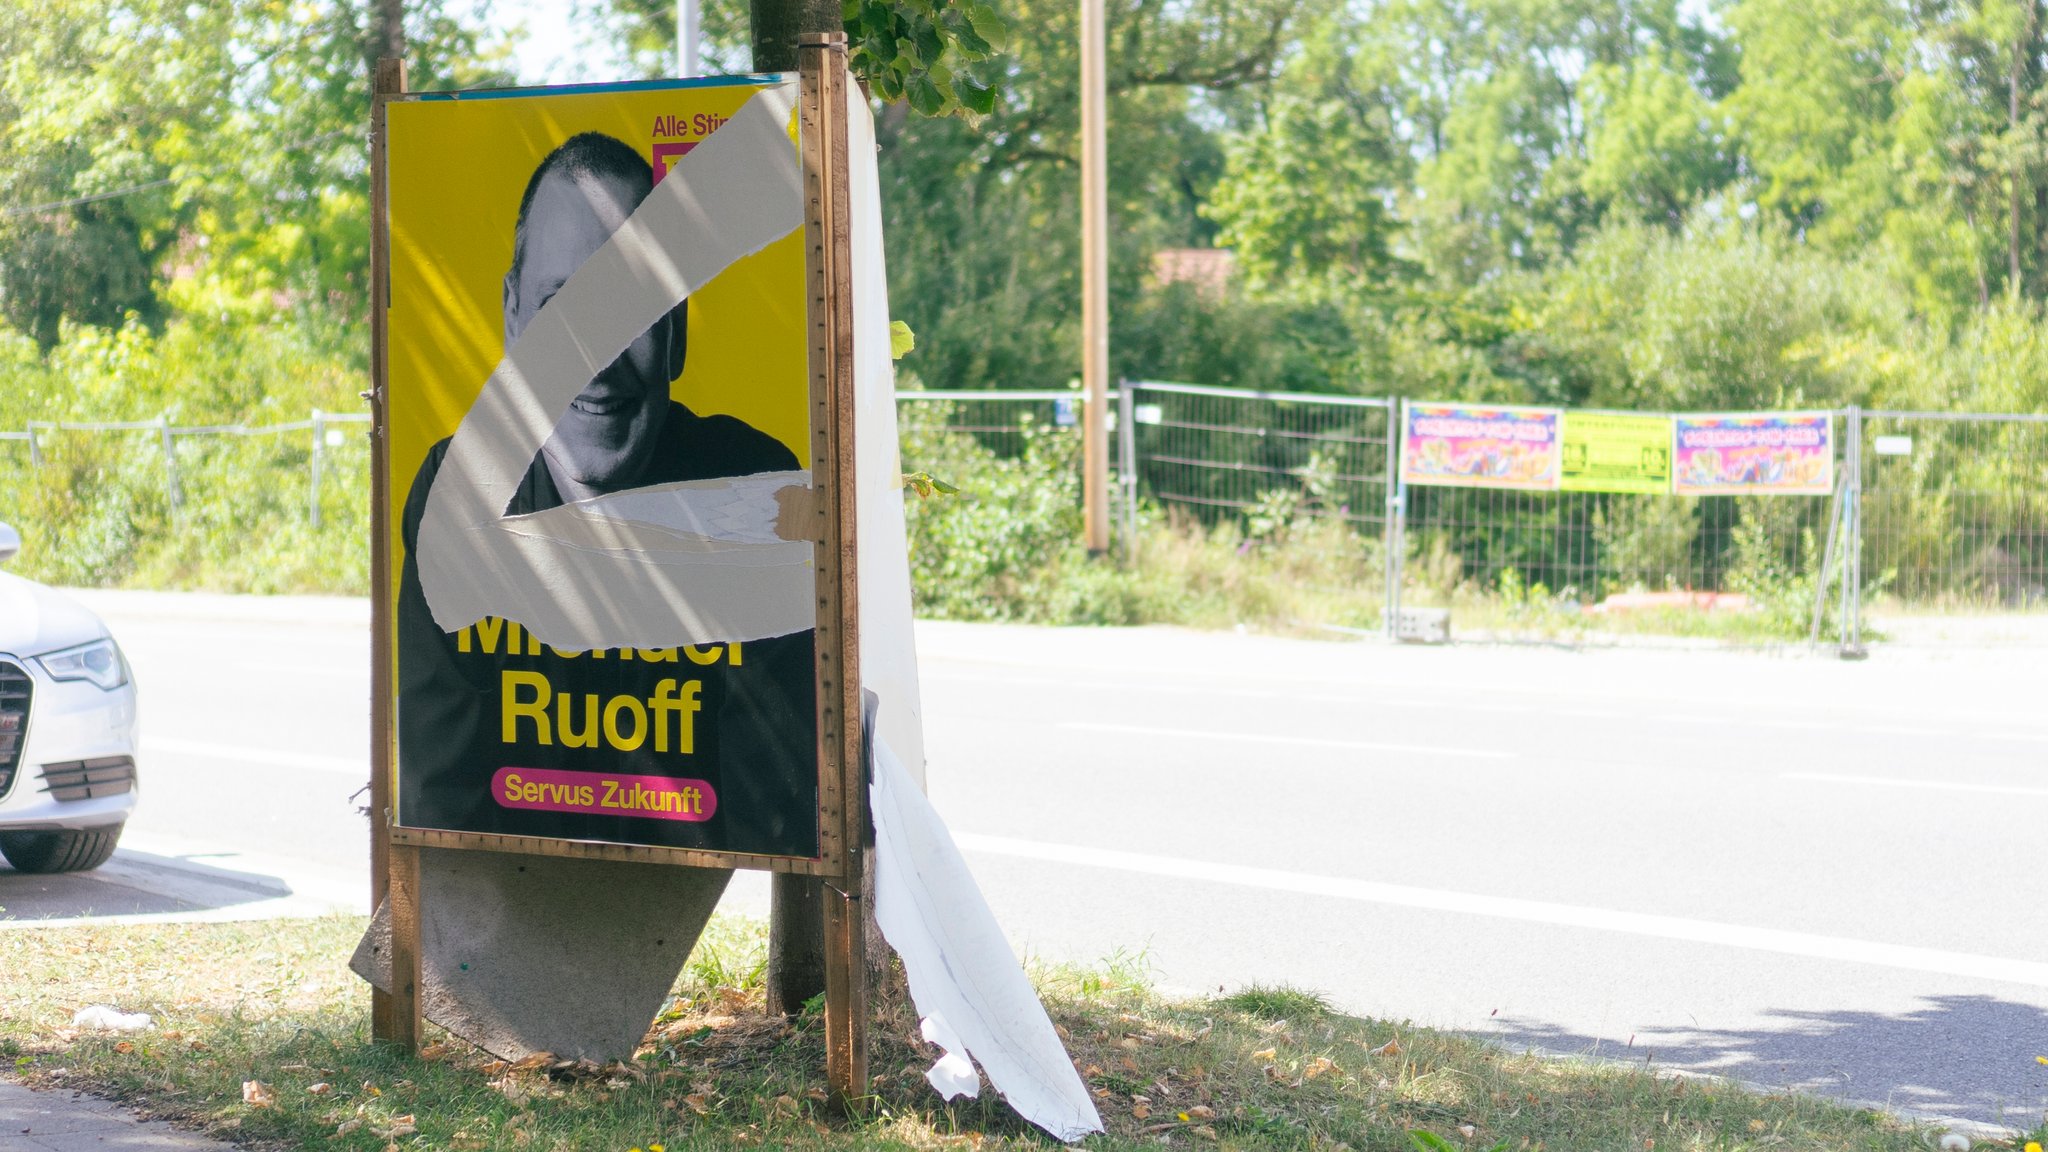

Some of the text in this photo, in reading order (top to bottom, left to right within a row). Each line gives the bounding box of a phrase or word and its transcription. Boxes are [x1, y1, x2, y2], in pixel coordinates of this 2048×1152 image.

[652, 115, 688, 137] Alle
[502, 670, 702, 754] Ruoff
[504, 773, 702, 814] Servus Zukunft
